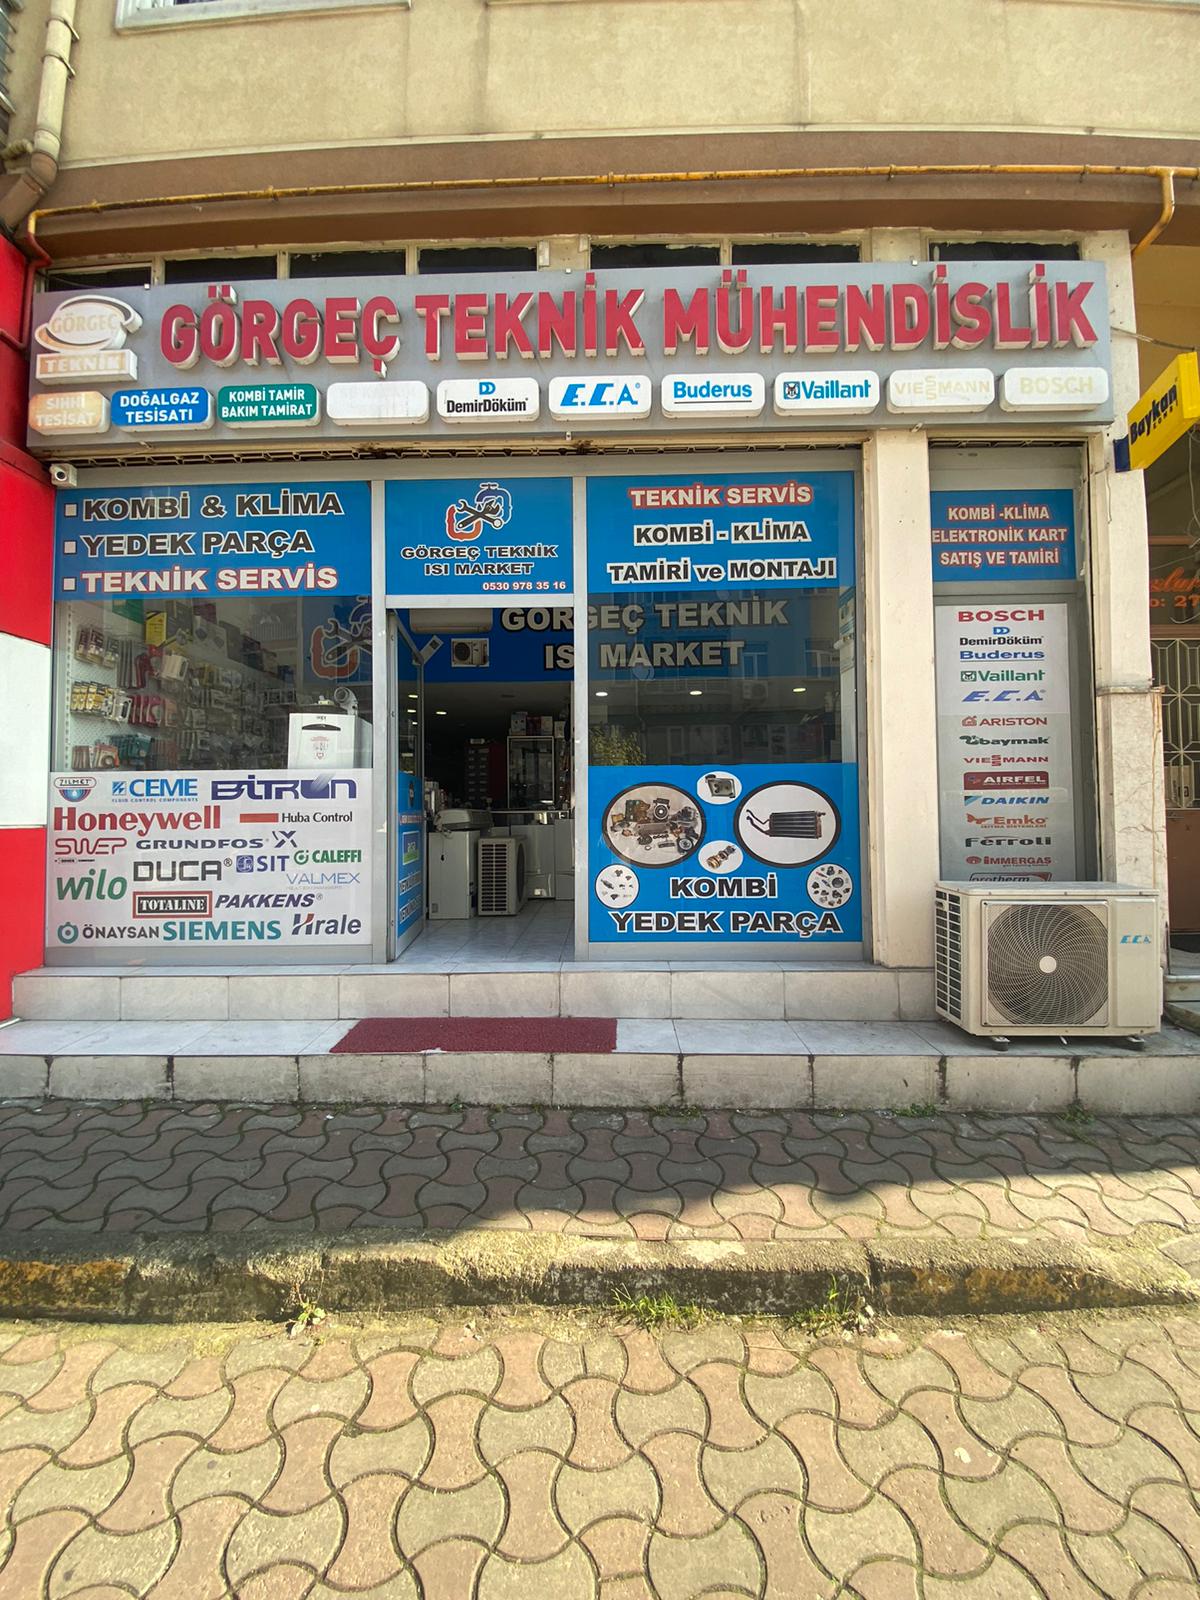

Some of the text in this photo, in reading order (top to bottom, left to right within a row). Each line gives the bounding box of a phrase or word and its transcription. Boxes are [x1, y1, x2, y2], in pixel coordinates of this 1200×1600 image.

[161, 264, 1098, 379] GÖRGEÇ TEKNİK MÜHENDİSLİK
[45, 354, 122, 373] TEKNİK
[229, 386, 305, 402] KOMBİ TAMİR
[673, 381, 753, 399] Buderus
[801, 380, 872, 400] Vaillant
[1019, 376, 1094, 395] BOSCH
[120, 391, 200, 407] DOĞALGAZ
[446, 397, 528, 414] DemirDöküm
[125, 408, 193, 424] TESİSATI
[221, 402, 313, 418] BAKIM TAMİRAT
[1130, 384, 1178, 445] Baykan
[631, 482, 812, 507] TEKNİK SERVİS
[82, 489, 344, 521] KOMBİ & KLİMA
[947, 504, 996, 521] KOMBİ
[634, 520, 714, 546] KOMBİ
[731, 518, 812, 544] KLİMA
[931, 526, 1068, 543] ELEKTRONİK KART
[80, 530, 315, 558] YEDEK PARÇA
[401, 542, 559, 561] GÖRGEÇ TEKNİK
[940, 548, 1060, 568] SATIŞ VE TAMİRİ
[80, 562, 338, 594] TEKNİK SERVİS
[424, 562, 534, 577] ISI MARKET
[607, 557, 837, 584] TAMİRİ ve MONTAJI
[482, 580, 567, 591] 0530 978 35 16
[654, 595, 789, 628] TEKNİK
[958, 609, 1045, 622] BOSCH
[960, 636, 1042, 646] DemirDöküm
[545, 641, 745, 669] IS MARKET
[960, 650, 1045, 660] Buderus
[978, 669, 1046, 682] Vaillant
[979, 717, 1048, 727] ARISTON
[979, 736, 1049, 746] baymak
[59, 779, 91, 787] ZILMET
[128, 778, 198, 797] CEME
[983, 775, 1046, 783] AIRFEL
[981, 796, 1050, 805] DAIKIN
[53, 805, 221, 837] Honeywell
[281, 811, 353, 823] Huba Control
[994, 814, 1047, 825] Emko
[55, 837, 128, 855] SWEP
[135, 838, 264, 850] GRUNDFOS
[965, 837, 1052, 847] Ferroli
[256, 855, 290, 872] SIT
[312, 849, 362, 864] CALEFFI
[983, 855, 1052, 865] IMMERGAS
[56, 868, 128, 901] wilo
[285, 872, 361, 885] VALMEX
[670, 871, 779, 899] KOMBİ
[139, 897, 205, 912] TOTALINE
[82, 924, 160, 939] ÖNAYSAN
[162, 920, 282, 941] SIEMENS
[608, 910, 844, 939] YEDEK PARÇA
